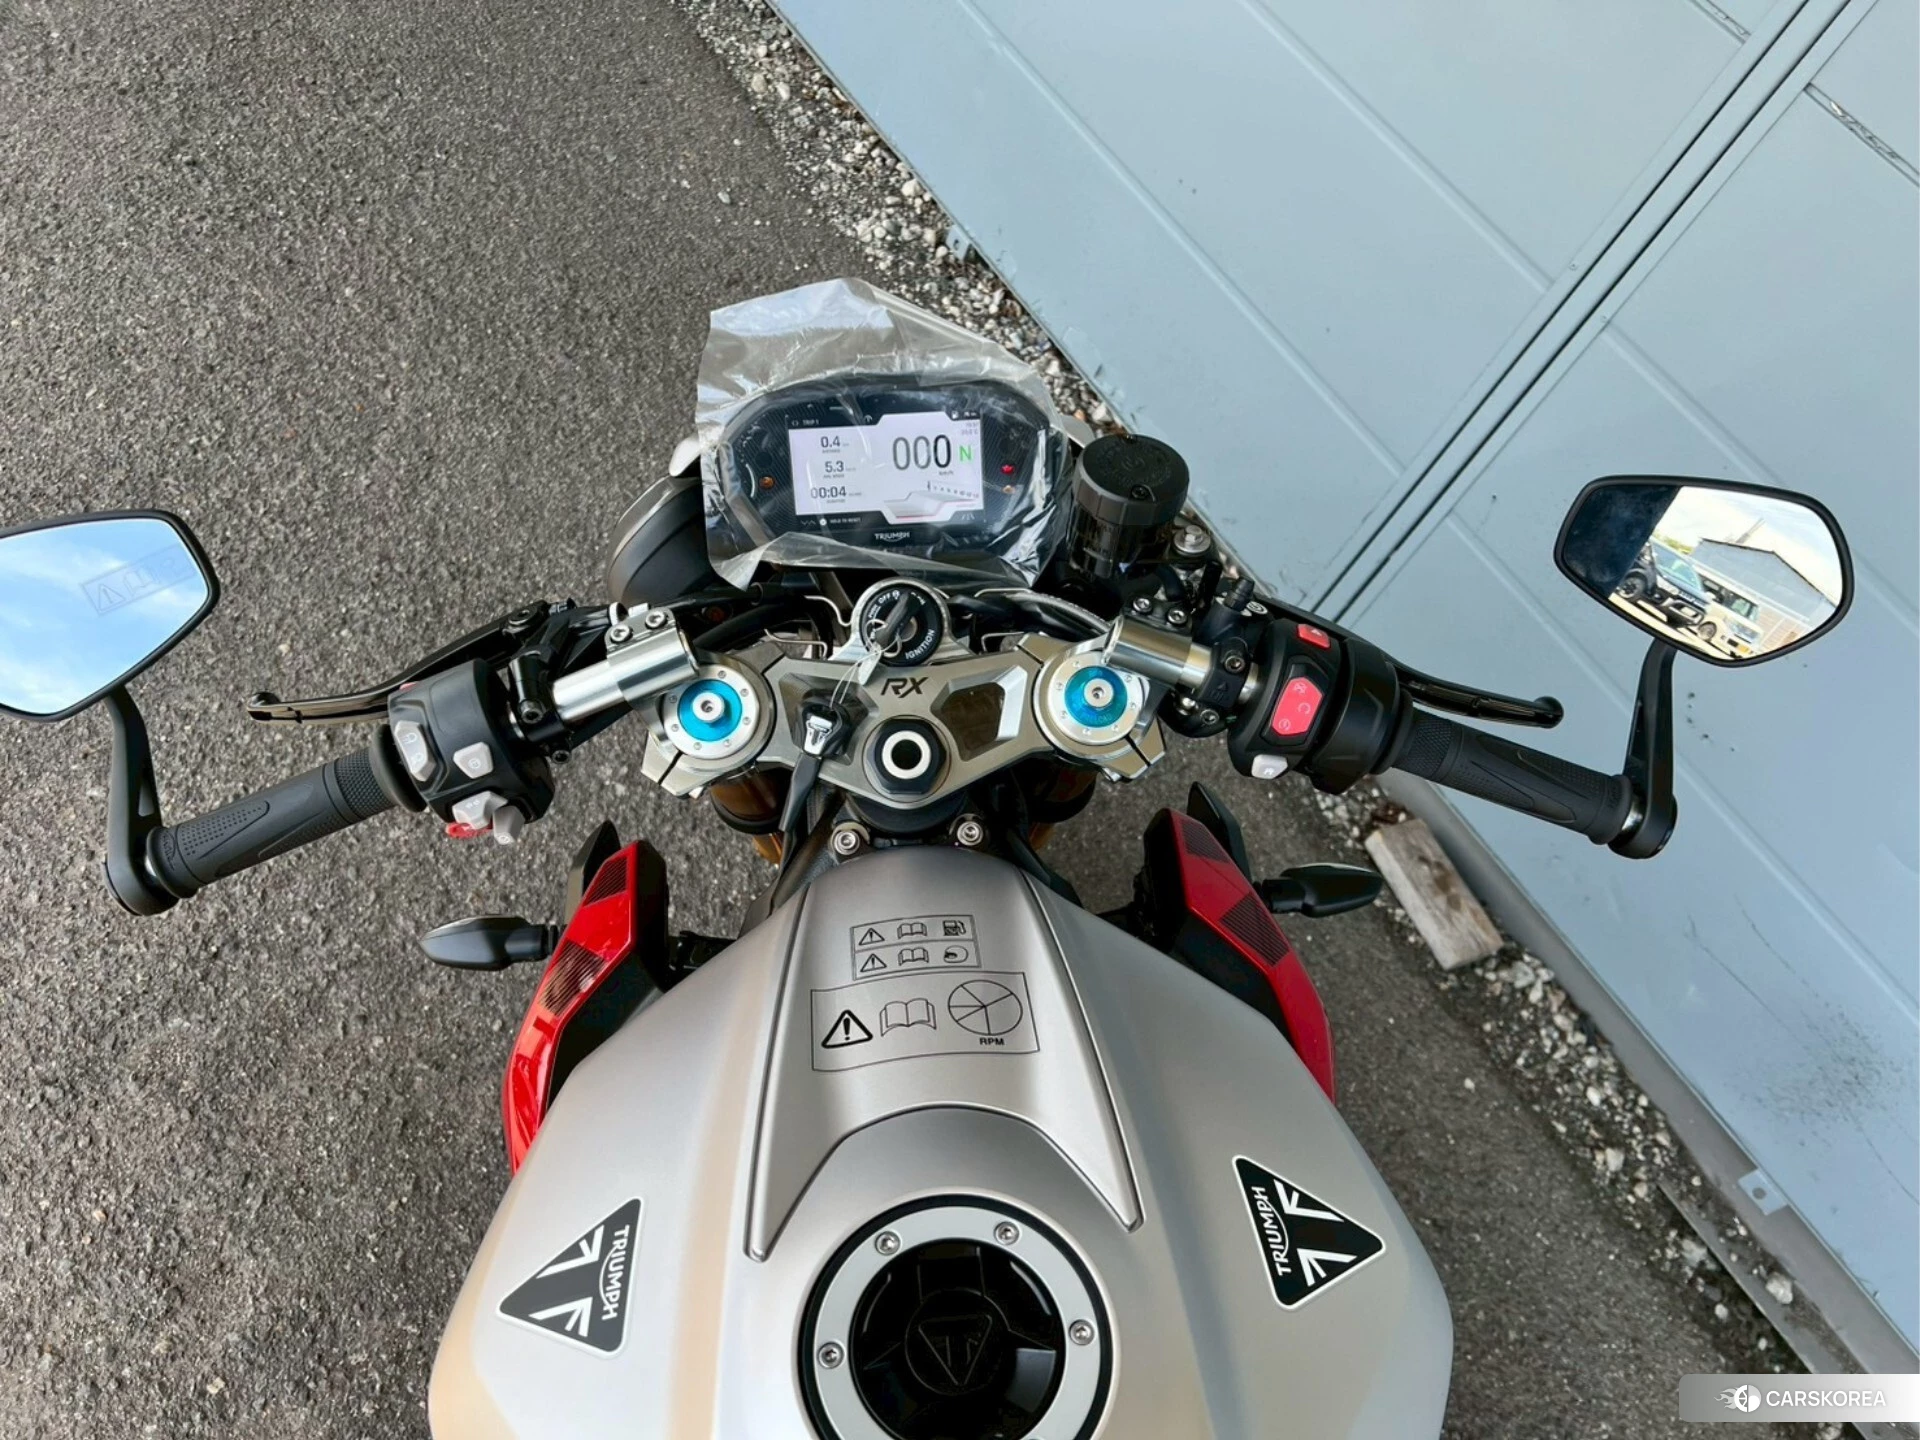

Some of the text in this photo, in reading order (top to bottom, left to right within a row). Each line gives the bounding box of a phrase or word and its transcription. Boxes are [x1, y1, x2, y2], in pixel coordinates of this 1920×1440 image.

[821, 436, 840, 448] 0.4
[892, 434, 973, 471] 000 N
[825, 461, 844, 473] 5.3
[811, 486, 846, 499] 00:04
[874, 530, 910, 543] TRIUMPH
[905, 629, 935, 660] IGNITION
[880, 677, 928, 698] RX
[979, 1037, 1005, 1046] RPM
[1251, 1186, 1291, 1276] TRIUMPH
[601, 1225, 630, 1320] TRIUMPH
